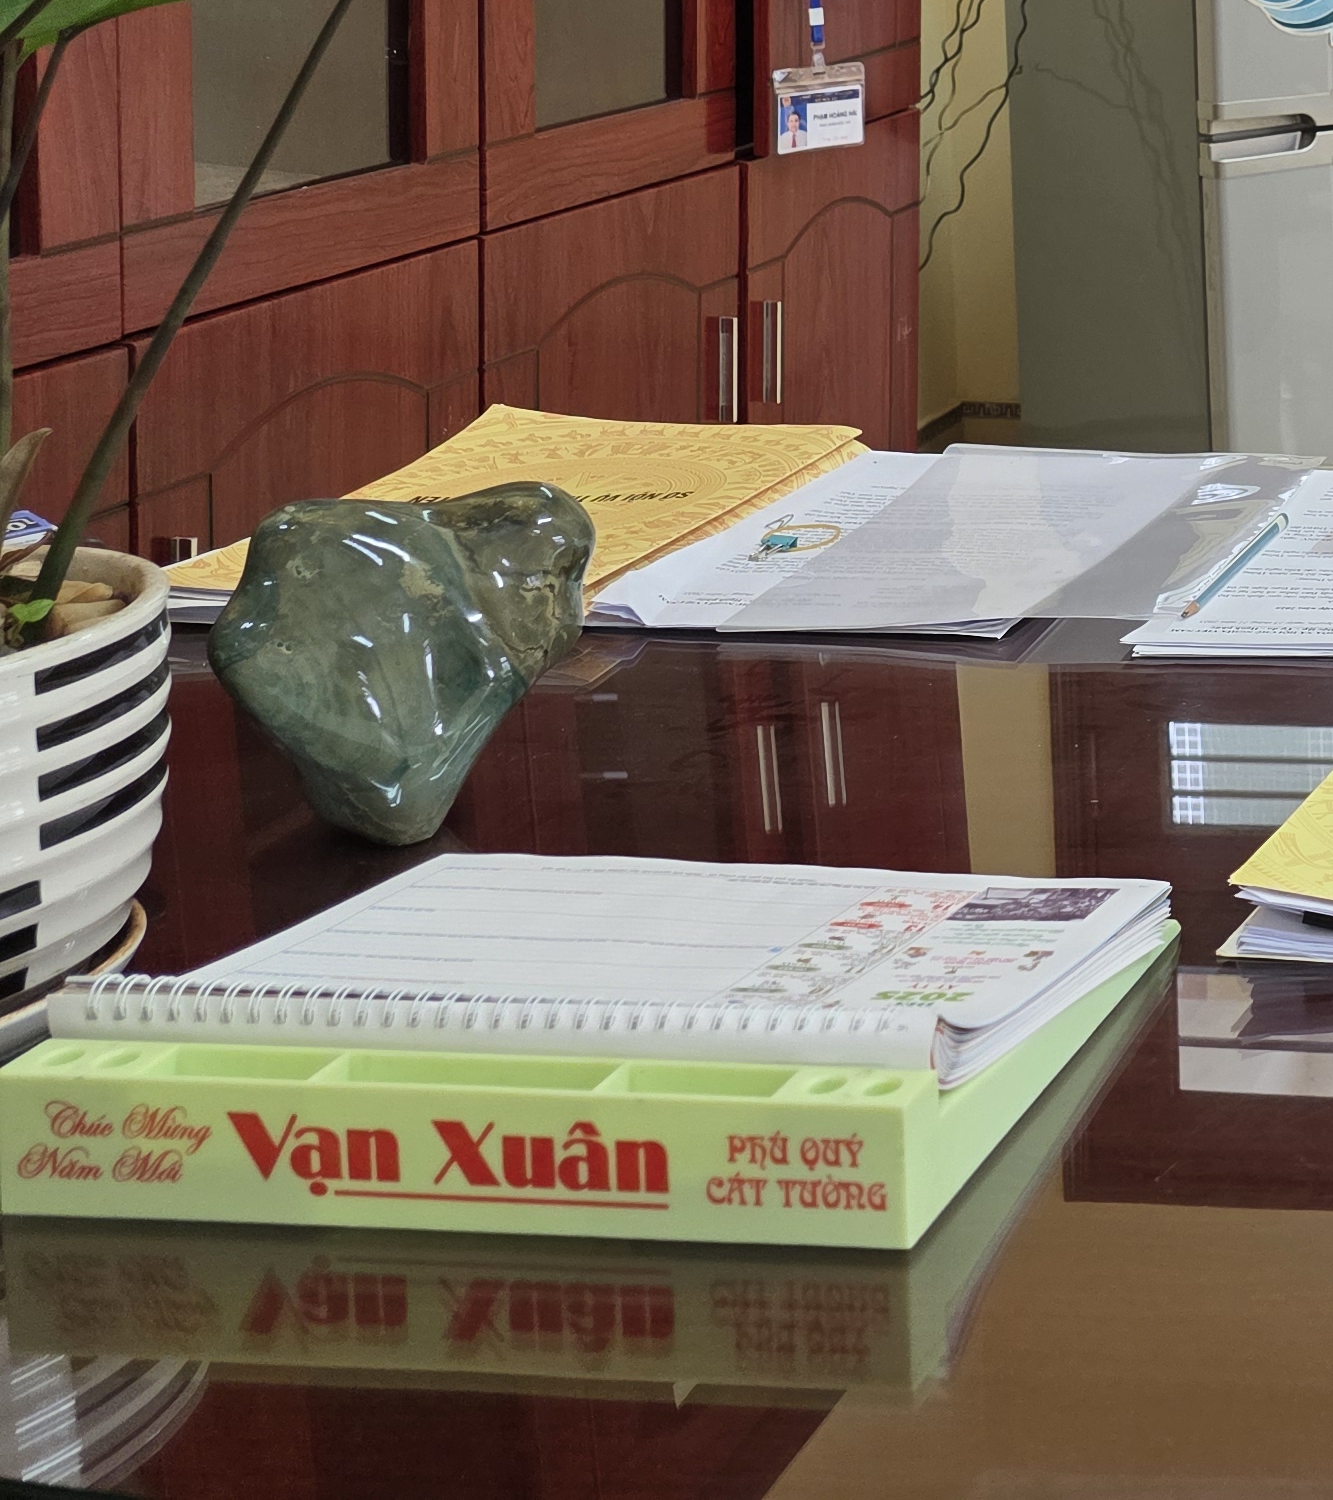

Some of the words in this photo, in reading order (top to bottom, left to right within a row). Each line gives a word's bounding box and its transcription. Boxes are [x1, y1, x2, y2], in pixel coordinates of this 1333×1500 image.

[869, 990, 974, 1003] 2025
[44, 1101, 115, 1139] Chúc
[119, 1103, 213, 1157] Mừng
[16, 1142, 105, 1180] Năm
[111, 1145, 185, 1184] Mới
[227, 1110, 401, 1197] Vạn
[430, 1119, 670, 1194] Xuân
[726, 1129, 790, 1171] PHÚ
[799, 1132, 865, 1172] QUÝ
[705, 1171, 768, 1208] CÁT
[776, 1173, 888, 1212] TƯỜNG
